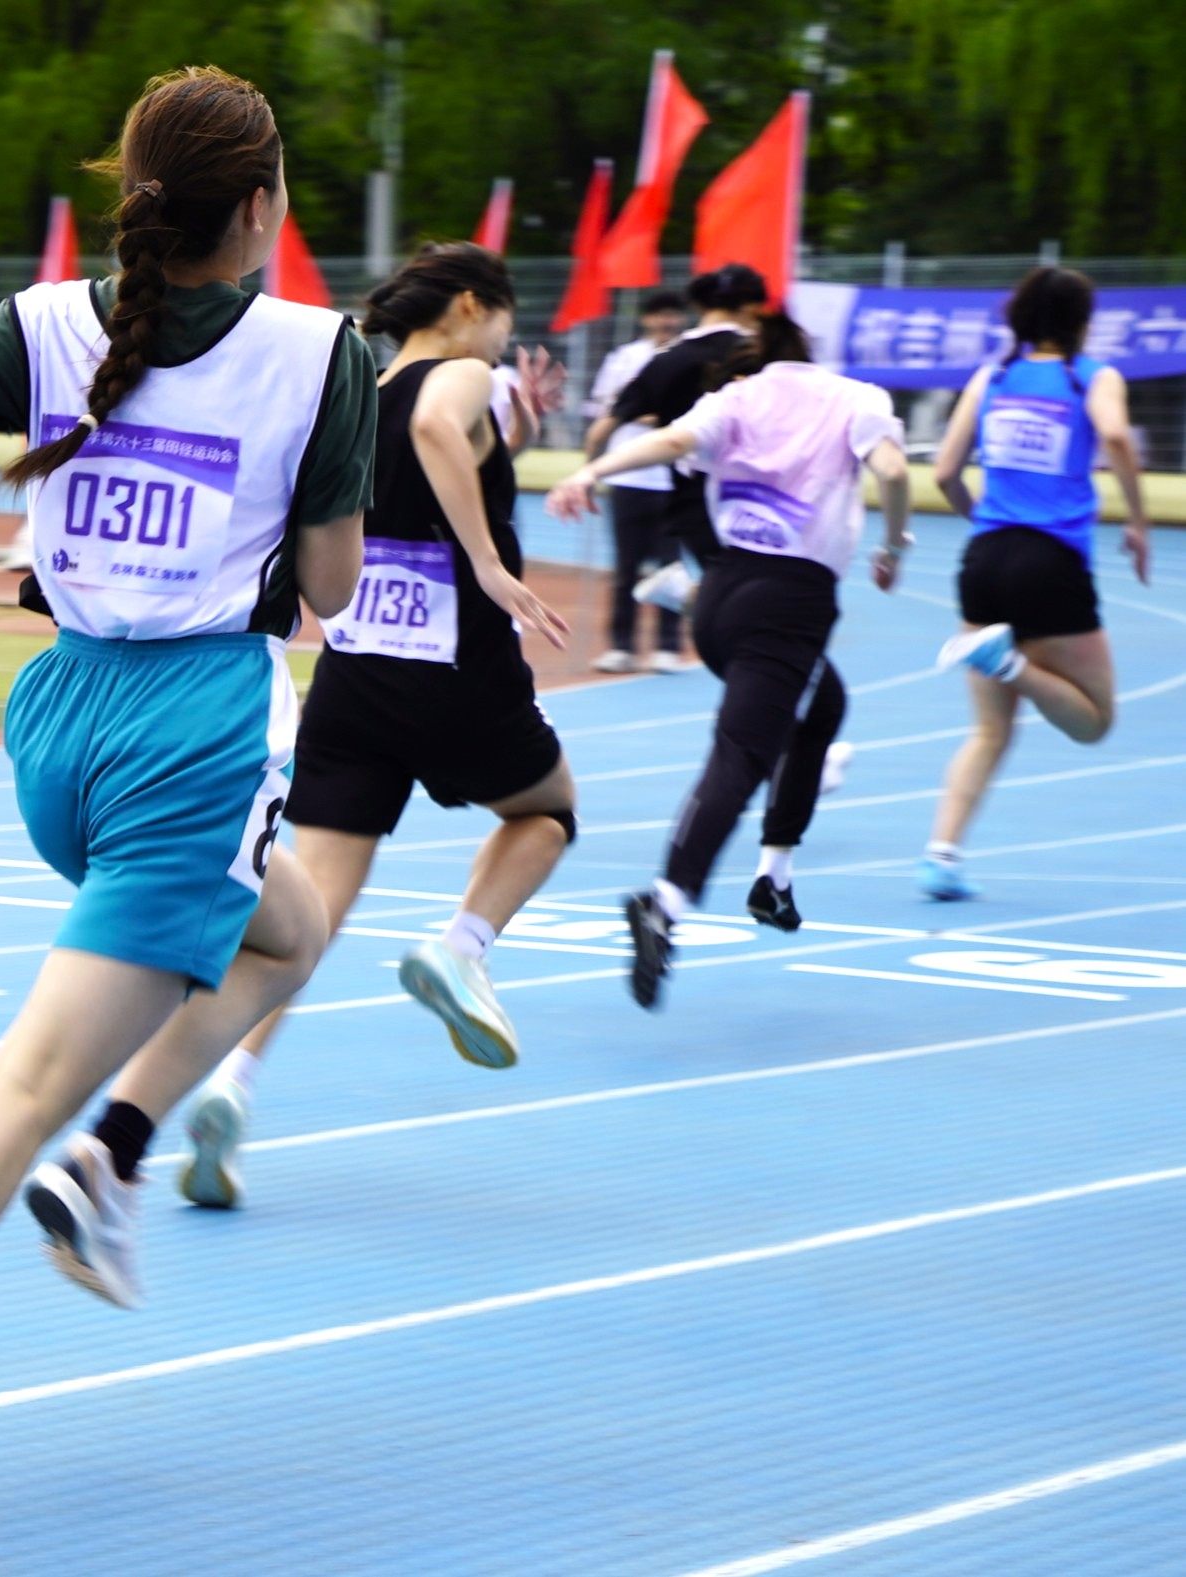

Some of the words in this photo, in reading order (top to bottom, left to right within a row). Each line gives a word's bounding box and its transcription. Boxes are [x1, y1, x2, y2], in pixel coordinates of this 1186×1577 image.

[65, 471, 196, 549] 0301
[354, 577, 430, 628] 1138
[908, 950, 1186, 988] 6
